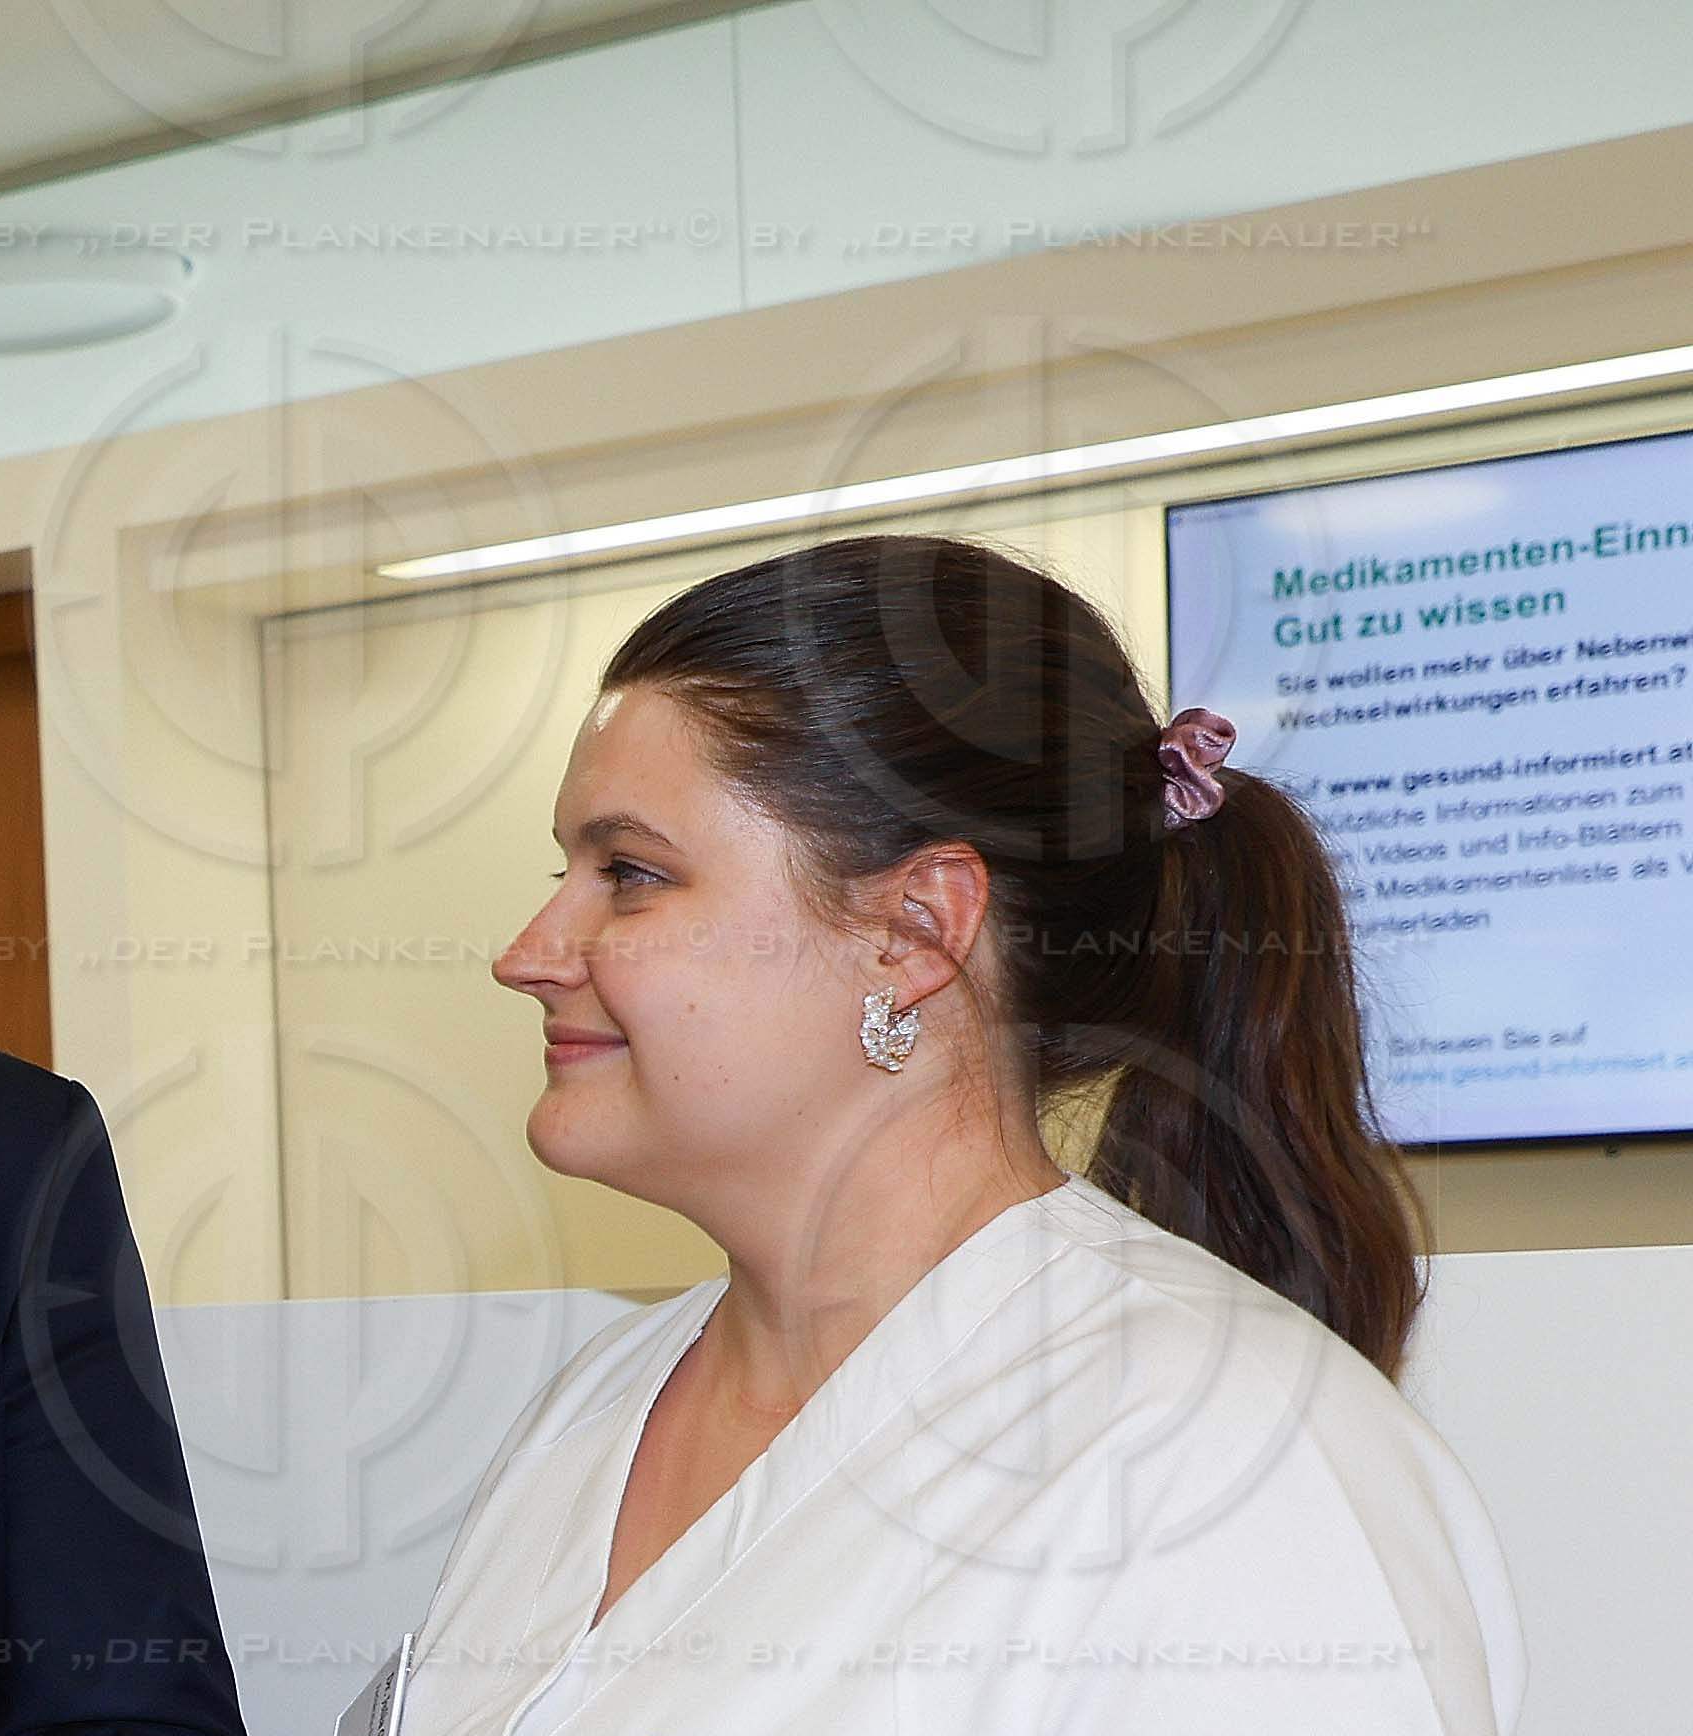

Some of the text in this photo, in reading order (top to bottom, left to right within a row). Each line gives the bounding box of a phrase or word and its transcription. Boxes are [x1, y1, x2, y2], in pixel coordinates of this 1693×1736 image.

[1273, 522, 1693, 600] Medikamenten-Einn
[1274, 588, 1566, 648] Gut zu wissen
[1278, 630, 1693, 697] Sie wollen mehr über Nebenw
[1276, 664, 1687, 730] Wechselwirkungen erfahren?
[1436, 787, 1617, 824] Informationen
[1625, 782, 1685, 807] zum
[1459, 832, 1511, 858] und
[1631, 855, 1670, 880] als
[1503, 1026, 1542, 1050] Sie
[1548, 1021, 1590, 1048] auf
